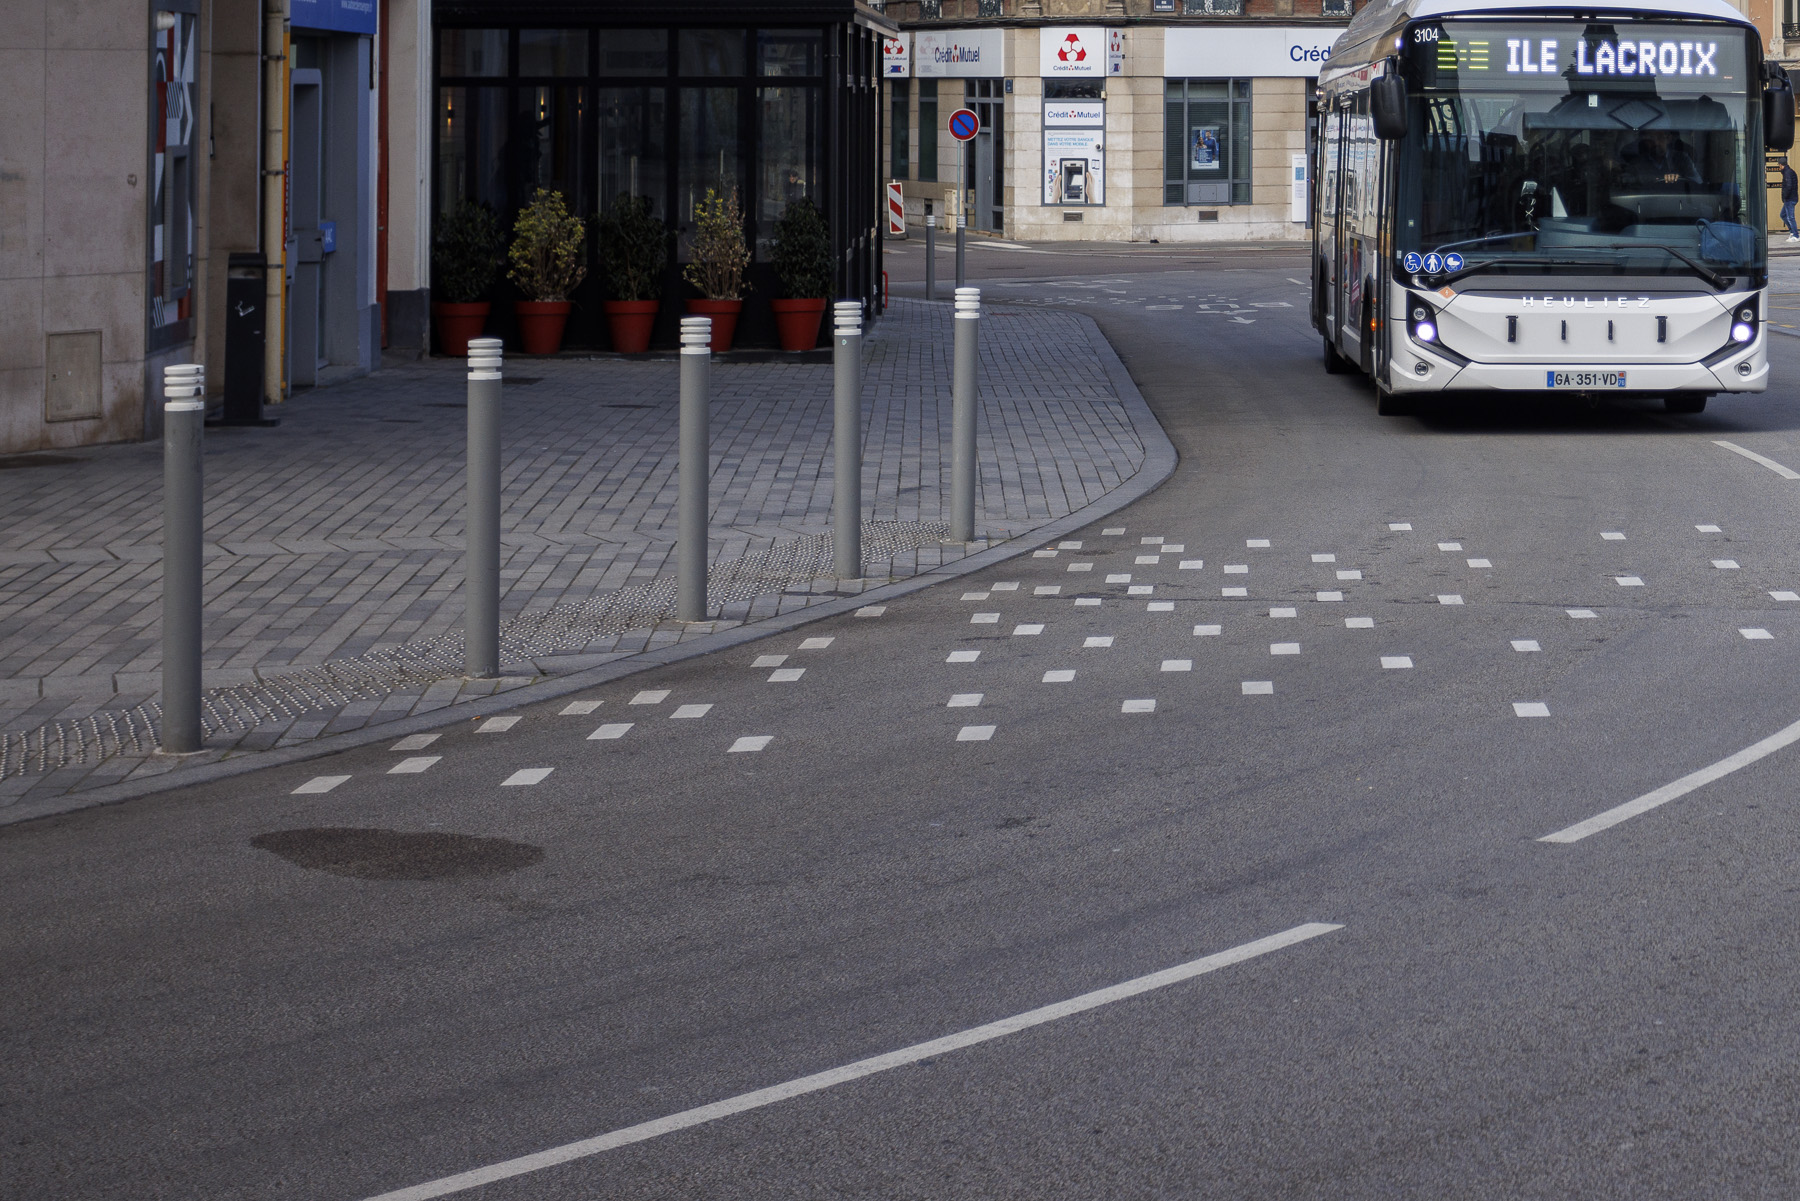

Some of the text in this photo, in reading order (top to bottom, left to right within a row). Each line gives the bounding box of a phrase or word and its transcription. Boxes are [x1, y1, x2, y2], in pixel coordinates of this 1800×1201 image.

[1414, 29, 1439, 43] 3104
[934, 46, 980, 63] Crédit Mutuel
[1506, 40, 1718, 75] ILE LACROIX
[1523, 297, 1650, 308] HEULIEZ
[1555, 374, 1617, 385] GA-351-VD
